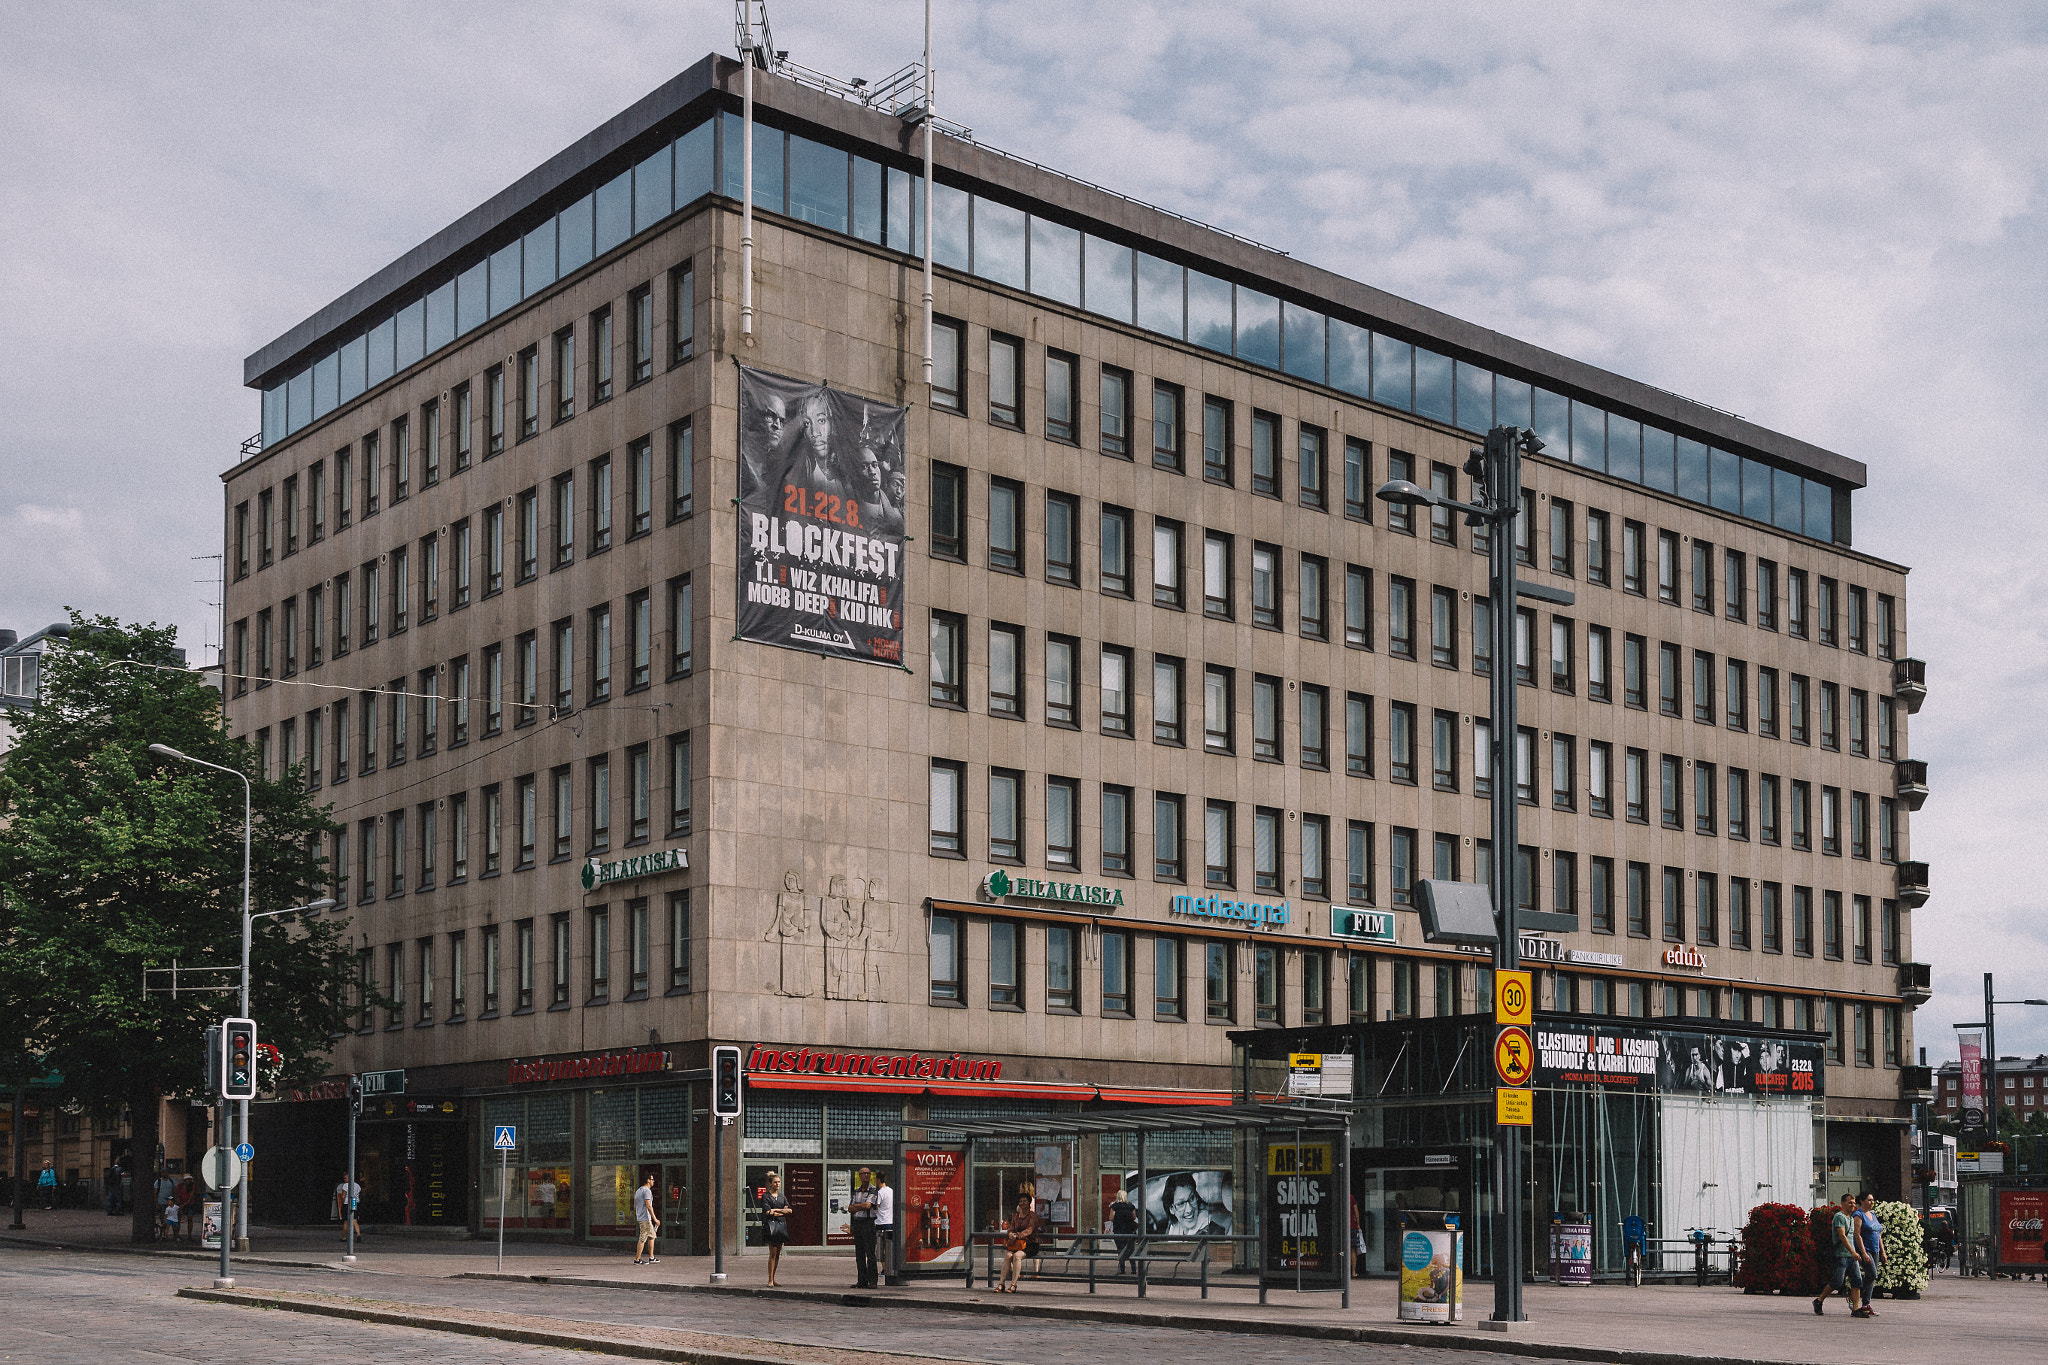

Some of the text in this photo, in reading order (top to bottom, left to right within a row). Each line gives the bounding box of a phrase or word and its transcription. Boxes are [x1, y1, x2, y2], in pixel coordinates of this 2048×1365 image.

[784, 484, 863, 529] 21.-22.8.
[751, 512, 899, 579] BLOCKFEST
[755, 561, 778, 584] T.I.
[790, 567, 817, 592] WIZ
[821, 574, 880, 605] KHALIFA
[748, 581, 790, 609] MOBB
[794, 590, 830, 615] DEEP
[840, 600, 866, 624] KID
[868, 605, 893, 629] INK
[794, 624, 844, 642] D-KULMA OY
[600, 848, 680, 882] EILAKAISLA
[1016, 878, 1124, 906] EILAKAISLA
[1176, 893, 1290, 927] mediasignal
[1352, 912, 1386, 934] FIM
[1571, 951, 1623, 965] PANKKIIRILIIKE
[1666, 944, 1707, 968] eduix
[1506, 989, 1521, 1007] 30
[1537, 1032, 1659, 1057] ELASTINEN JVG KASMIR
[508, 1048, 664, 1084] instrumentarium
[749, 1043, 1002, 1079] instrumentarium
[1541, 1051, 1656, 1074] RUUDOLF & KARRI KOIRA
[365, 1074, 385, 1092] FIM
[1755, 1073, 1788, 1086] BLOCKFEST
[1792, 1072, 1814, 1090] 2015
[917, 1154, 953, 1166] VOITA
[1275, 1147, 1323, 1172] ARJEN
[428, 1133, 445, 1217] nightclub
[1277, 1177, 1326, 1205] SÄÄS-
[1280, 1209, 1318, 1237] TÖJÄ
[2009, 1218, 2043, 1230] Coca-Cola
[1421, 1305, 1449, 1313] FRESSI
